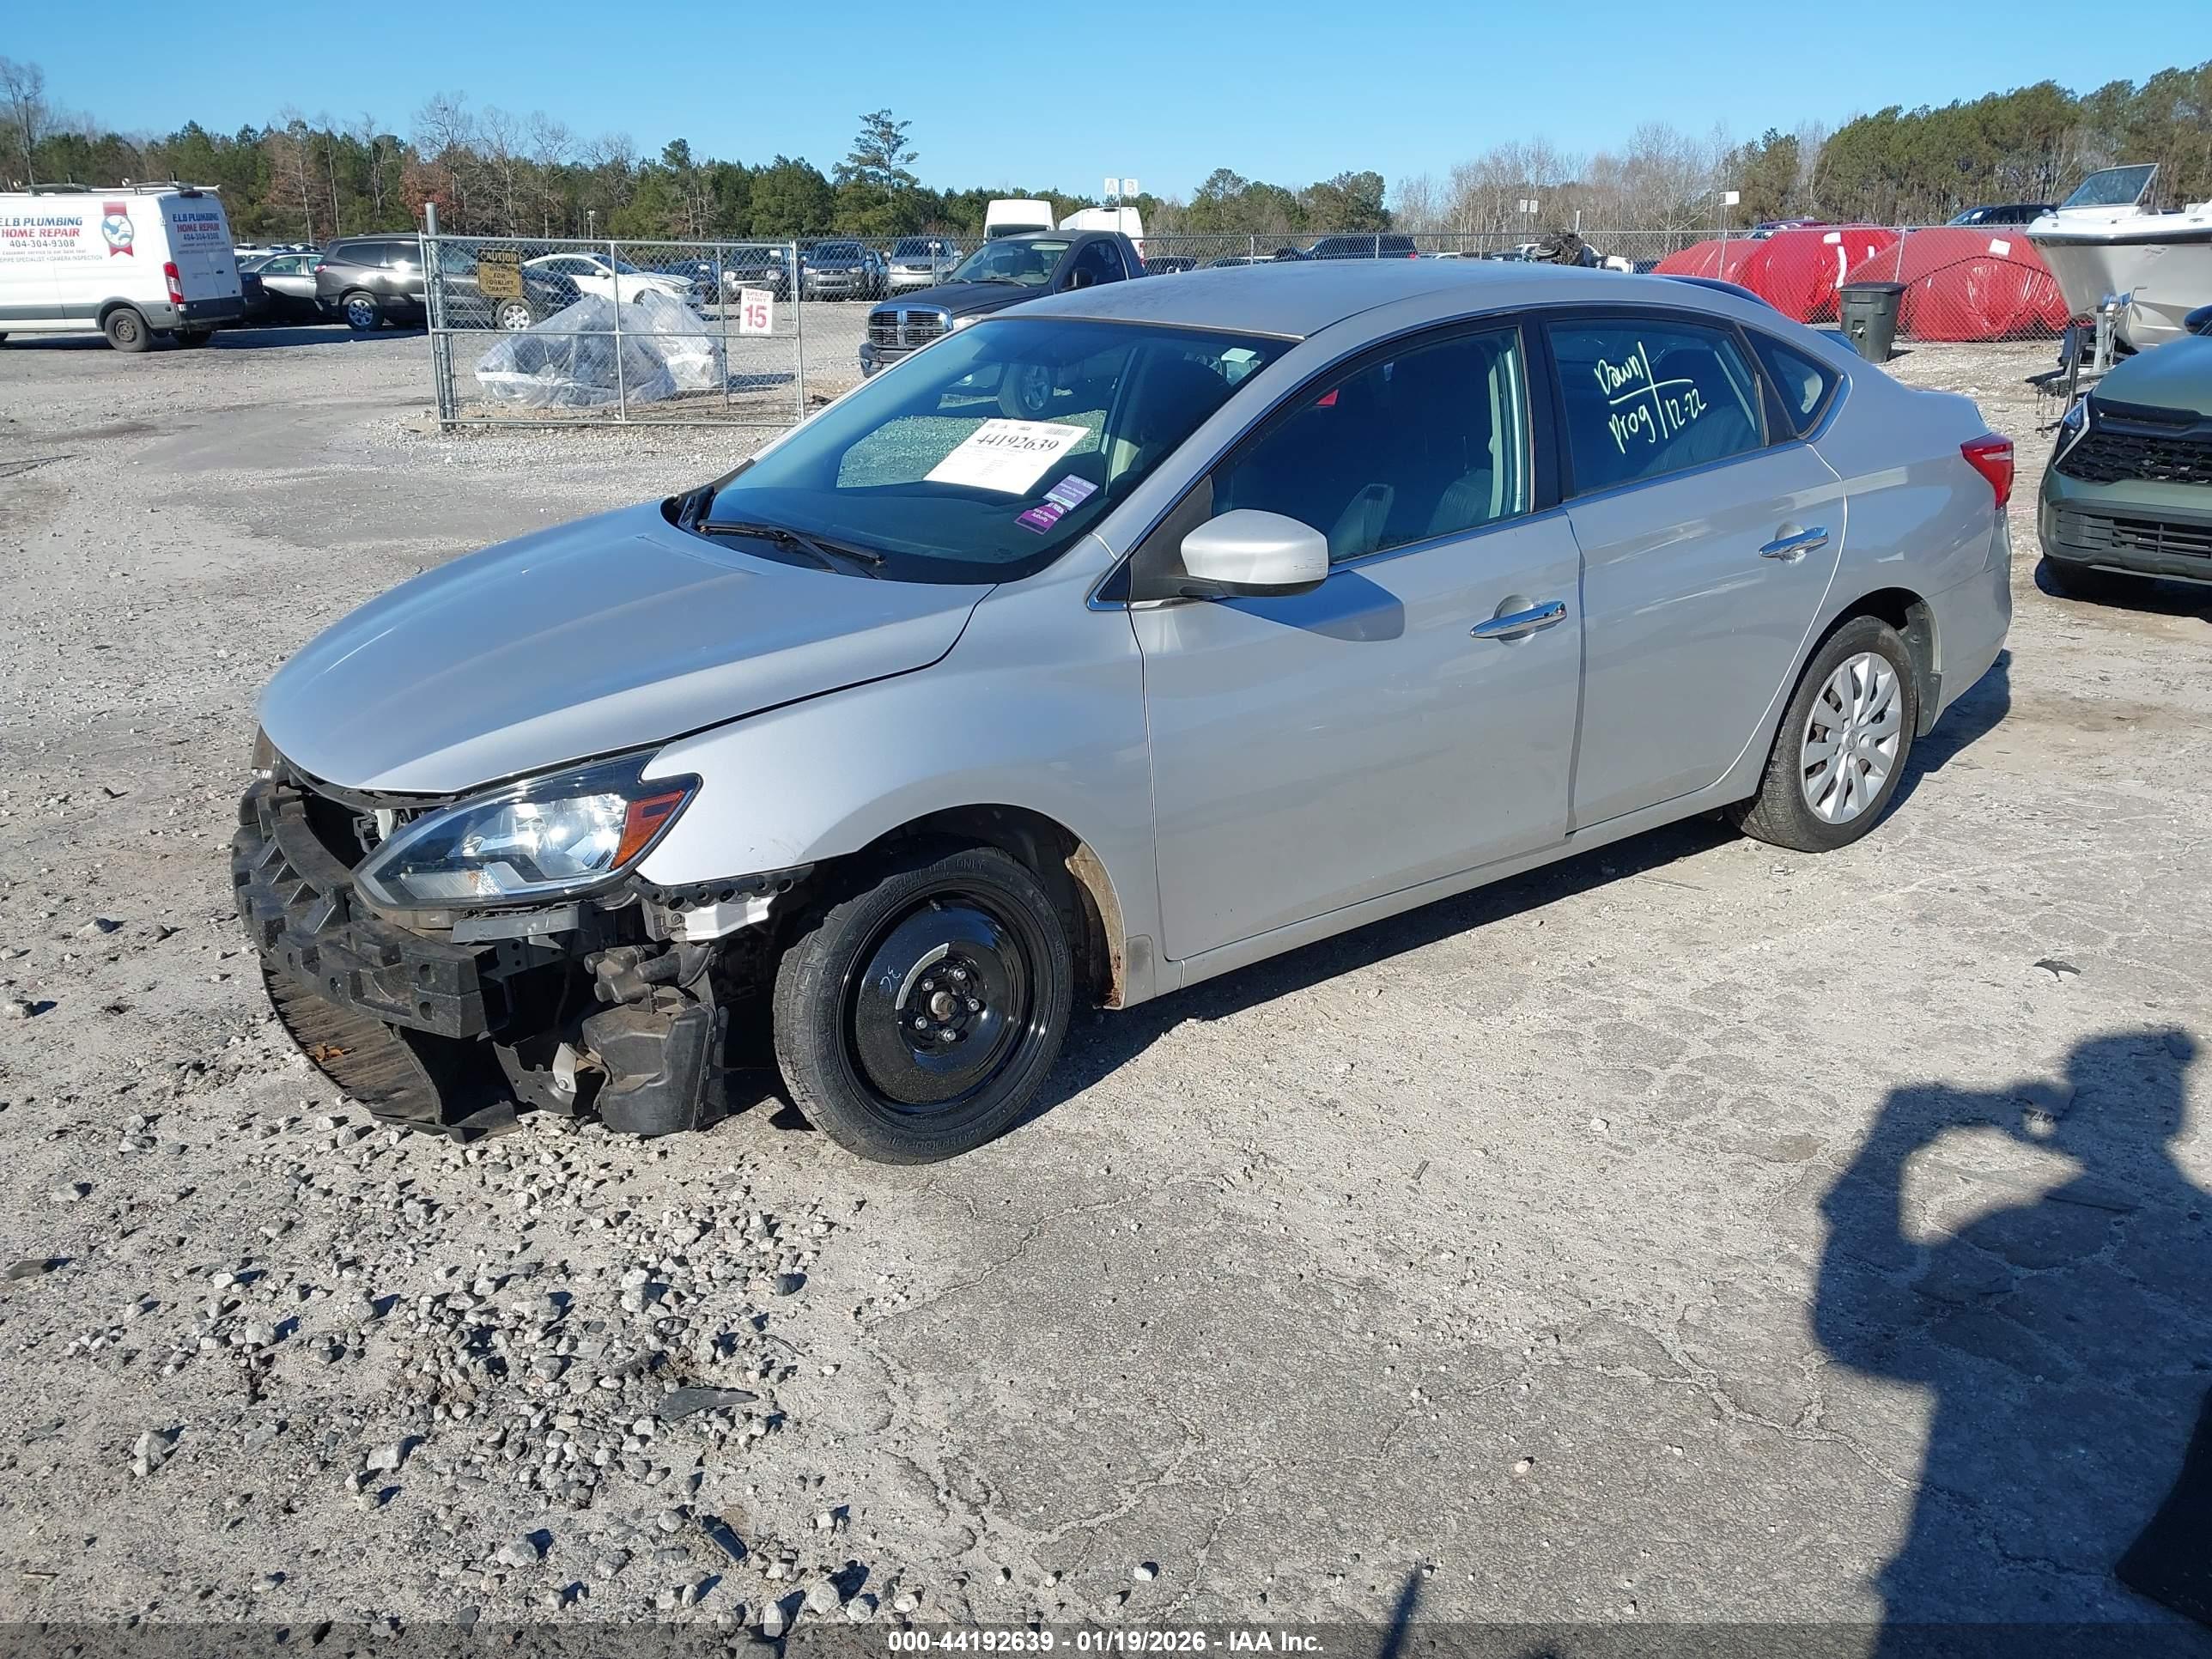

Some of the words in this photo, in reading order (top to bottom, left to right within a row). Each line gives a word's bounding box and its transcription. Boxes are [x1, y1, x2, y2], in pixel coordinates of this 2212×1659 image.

[1107, 179, 1116, 193] A
[1127, 180, 1134, 193] B
[23, 216, 82, 227] PLUMBING
[2, 228, 35, 238] HOME
[39, 228, 81, 238] REPAIR
[177, 224, 198, 233] HOME
[480, 251, 518, 261] CAUTION
[744, 304, 767, 328] 15
[1594, 355, 1644, 396] Dawn
[976, 433, 1060, 452] 44192639
